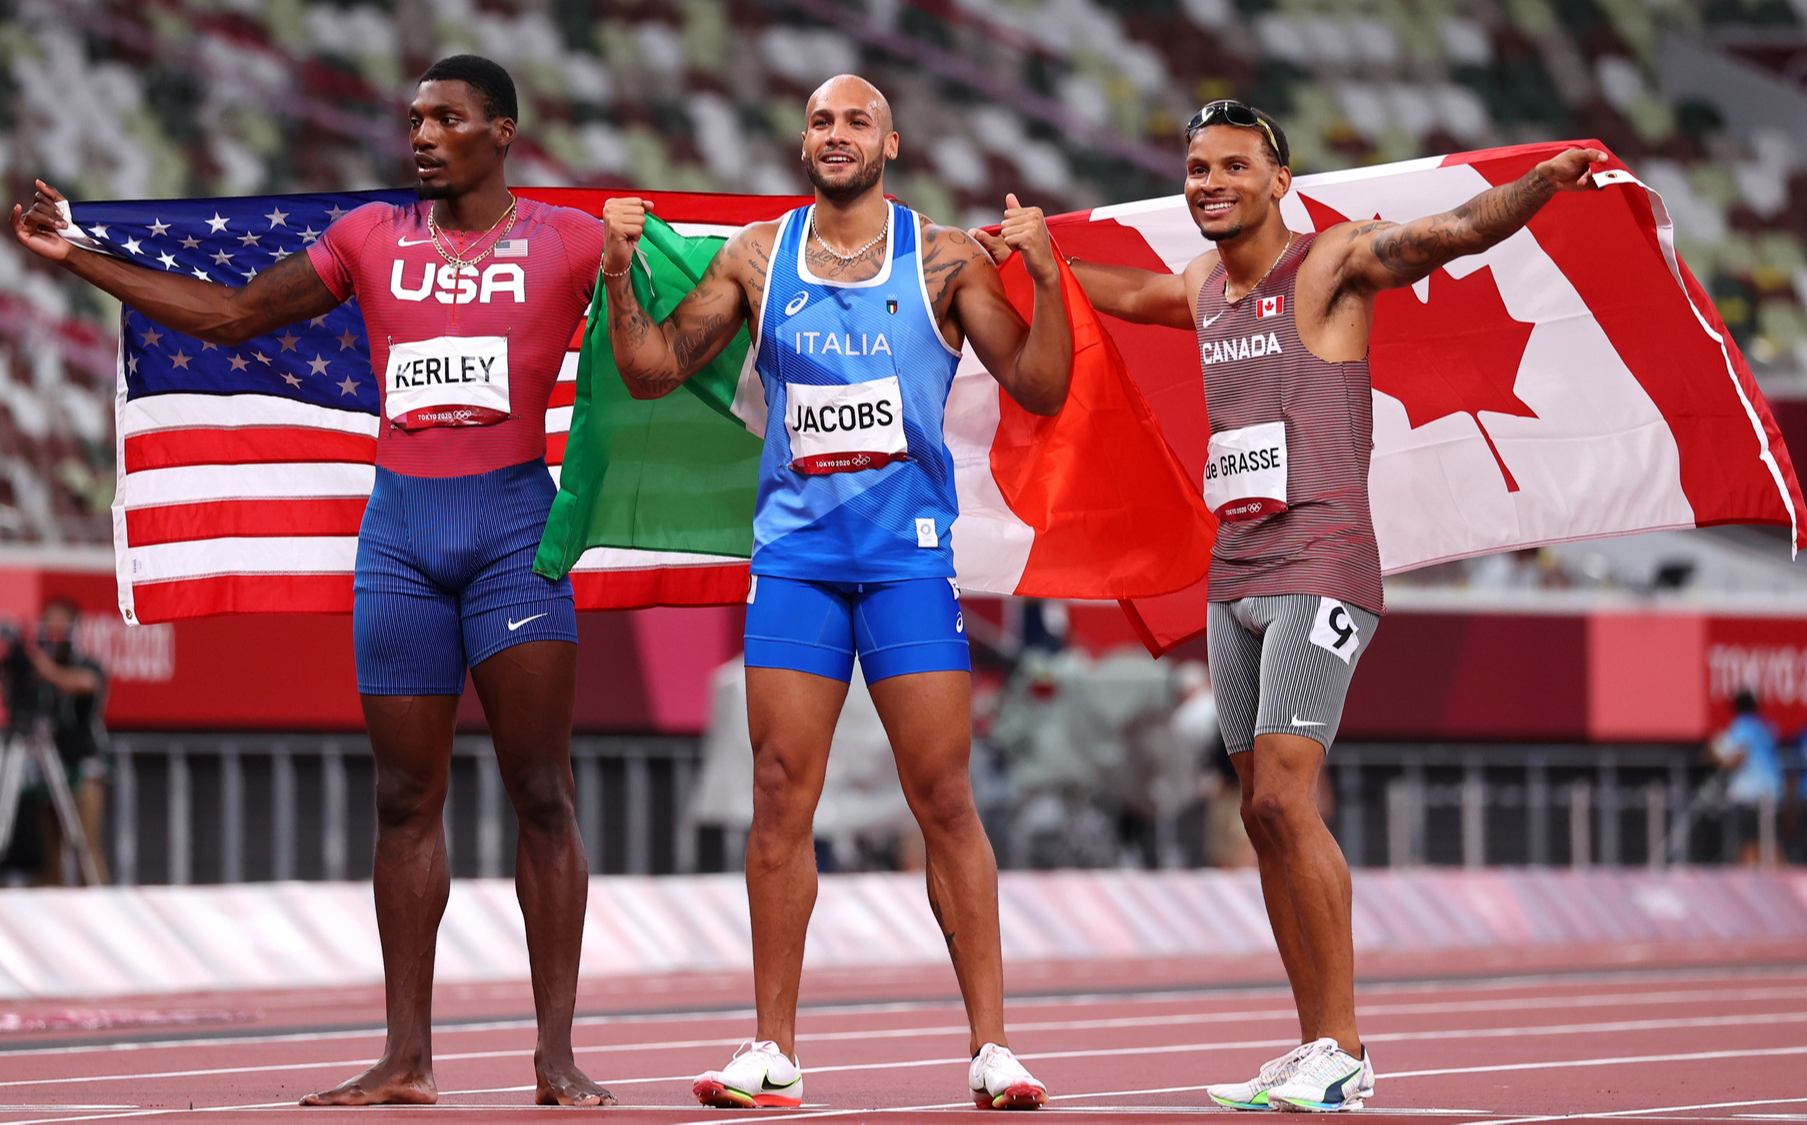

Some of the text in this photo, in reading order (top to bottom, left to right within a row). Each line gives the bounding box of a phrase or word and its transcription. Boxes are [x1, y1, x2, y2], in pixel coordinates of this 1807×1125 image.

[390, 258, 526, 305] USA
[795, 331, 892, 356] ITALIA
[1202, 331, 1283, 364] CANADA
[395, 355, 496, 389] KERLEY
[418, 412, 452, 421] TOKYO 2020
[792, 399, 893, 433] JACOBS
[815, 459, 851, 468] TOKYO 2020
[1205, 447, 1281, 480] de GRASSE
[1225, 506, 1247, 516] TOKYO 2020
[1328, 606, 1354, 649] 9
